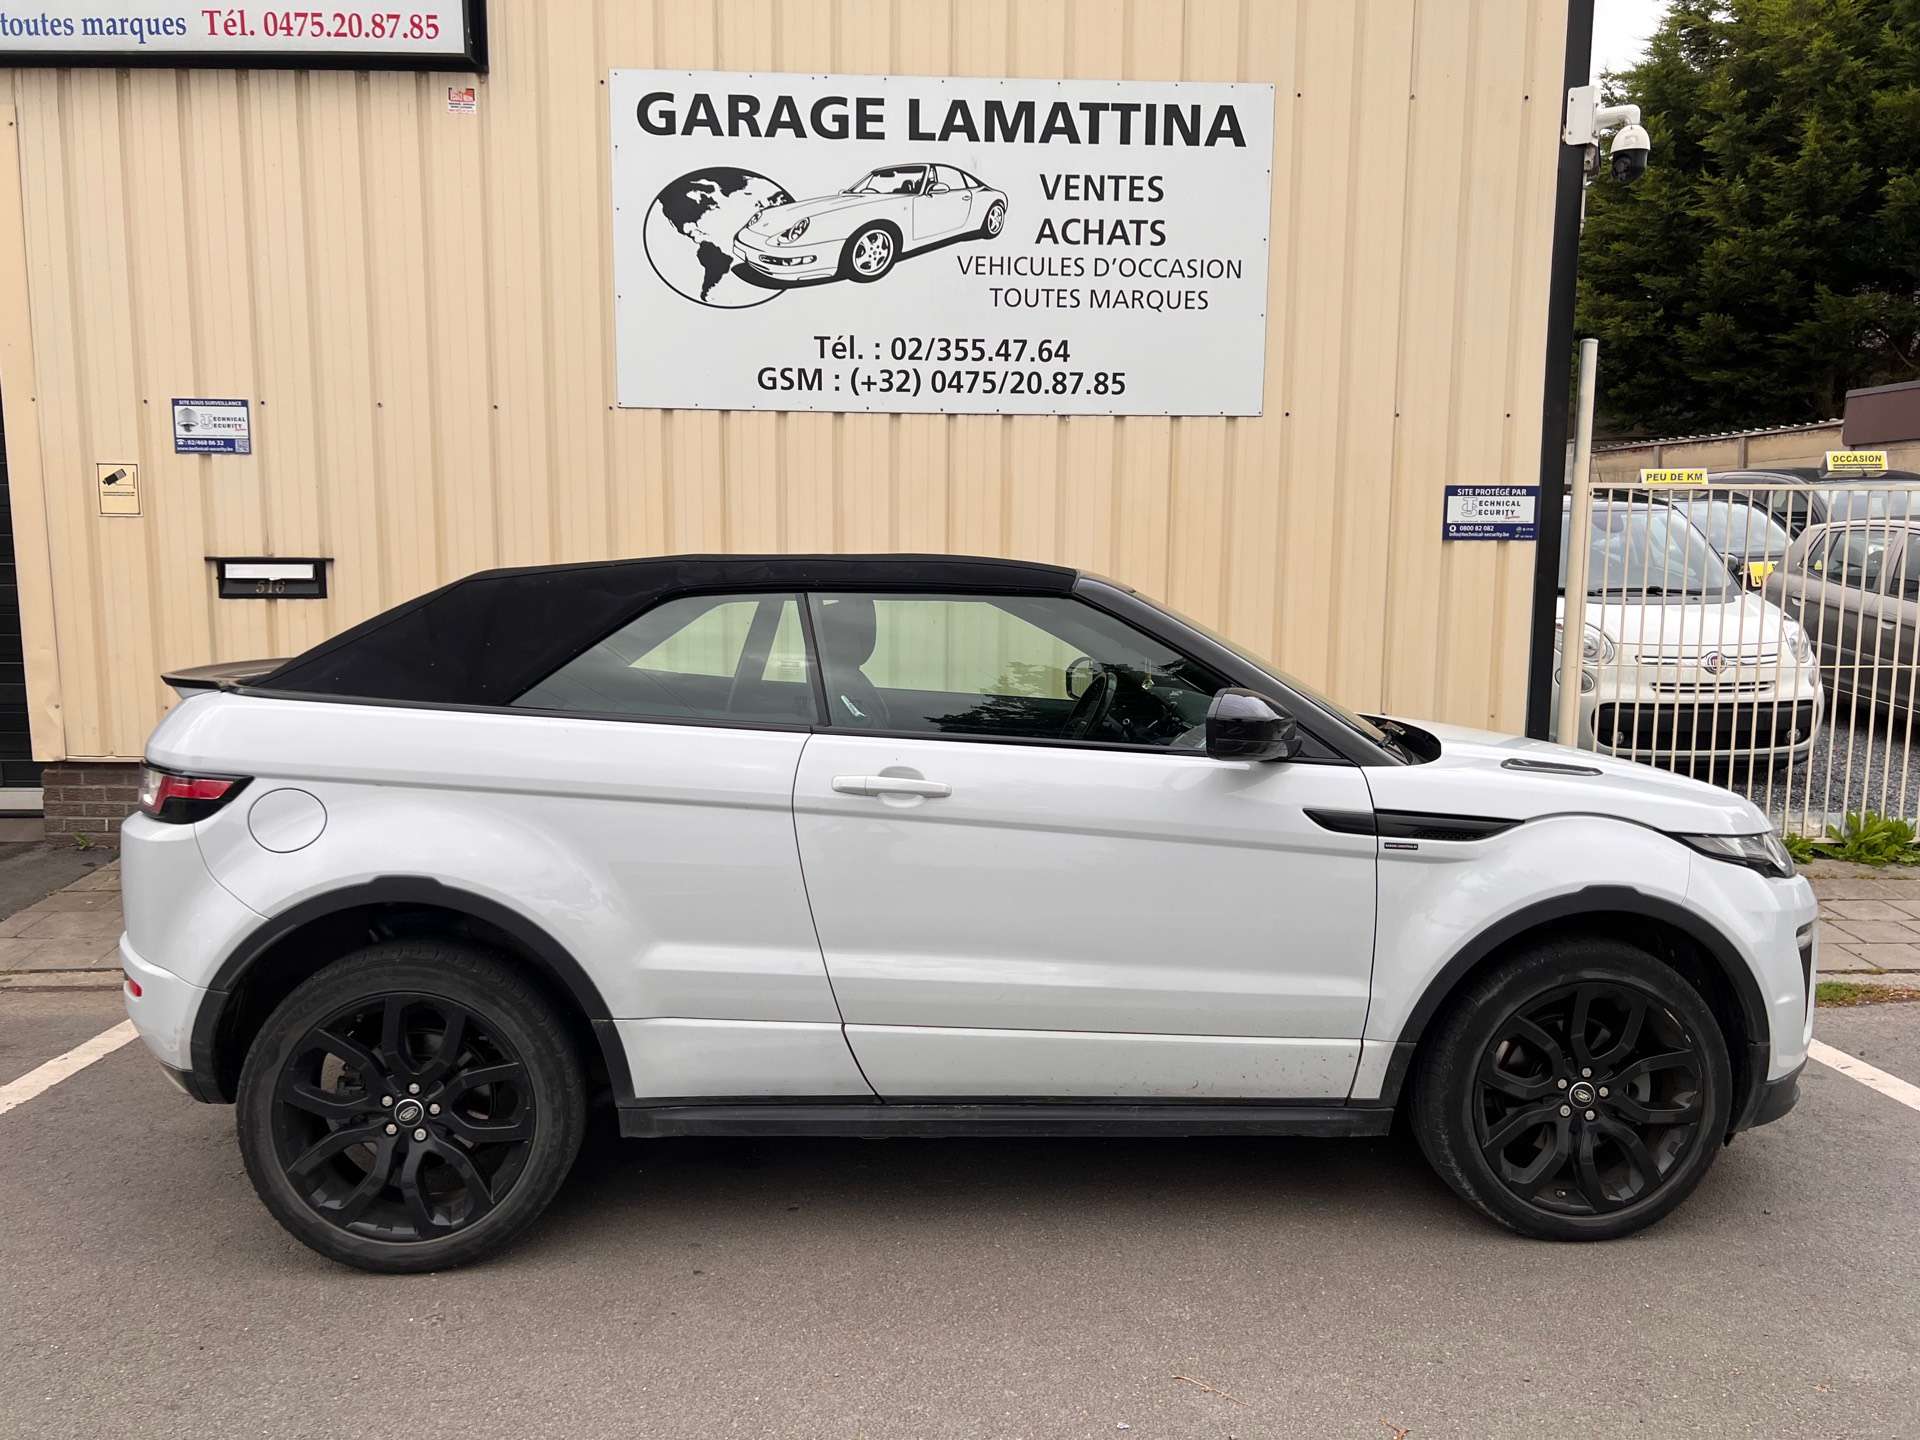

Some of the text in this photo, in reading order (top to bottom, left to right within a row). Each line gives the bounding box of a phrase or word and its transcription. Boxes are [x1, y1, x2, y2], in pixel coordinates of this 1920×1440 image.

[0, 9, 440, 44] toutes marques Tél. 0475.20.87.85
[636, 92, 1247, 148] GARAGE LAMATTINA
[1040, 173, 1164, 203] VENTES
[1035, 218, 1166, 247] ACHATS
[956, 255, 1242, 280] VEHICULES D'OCCASION
[989, 287, 1209, 313] TOUTES MARQUES
[813, 335, 864, 360] Tél.
[890, 337, 1071, 364] 02/355.47.64
[757, 367, 823, 392] GSM
[850, 368, 922, 396] (+32)
[931, 370, 1126, 396] 0475/20.87.85
[1832, 454, 1882, 463] OCCASION
[1457, 487, 1527, 496] SITE PROTÉGÉ PAR
[1646, 472, 1703, 482] PEU DE KM
